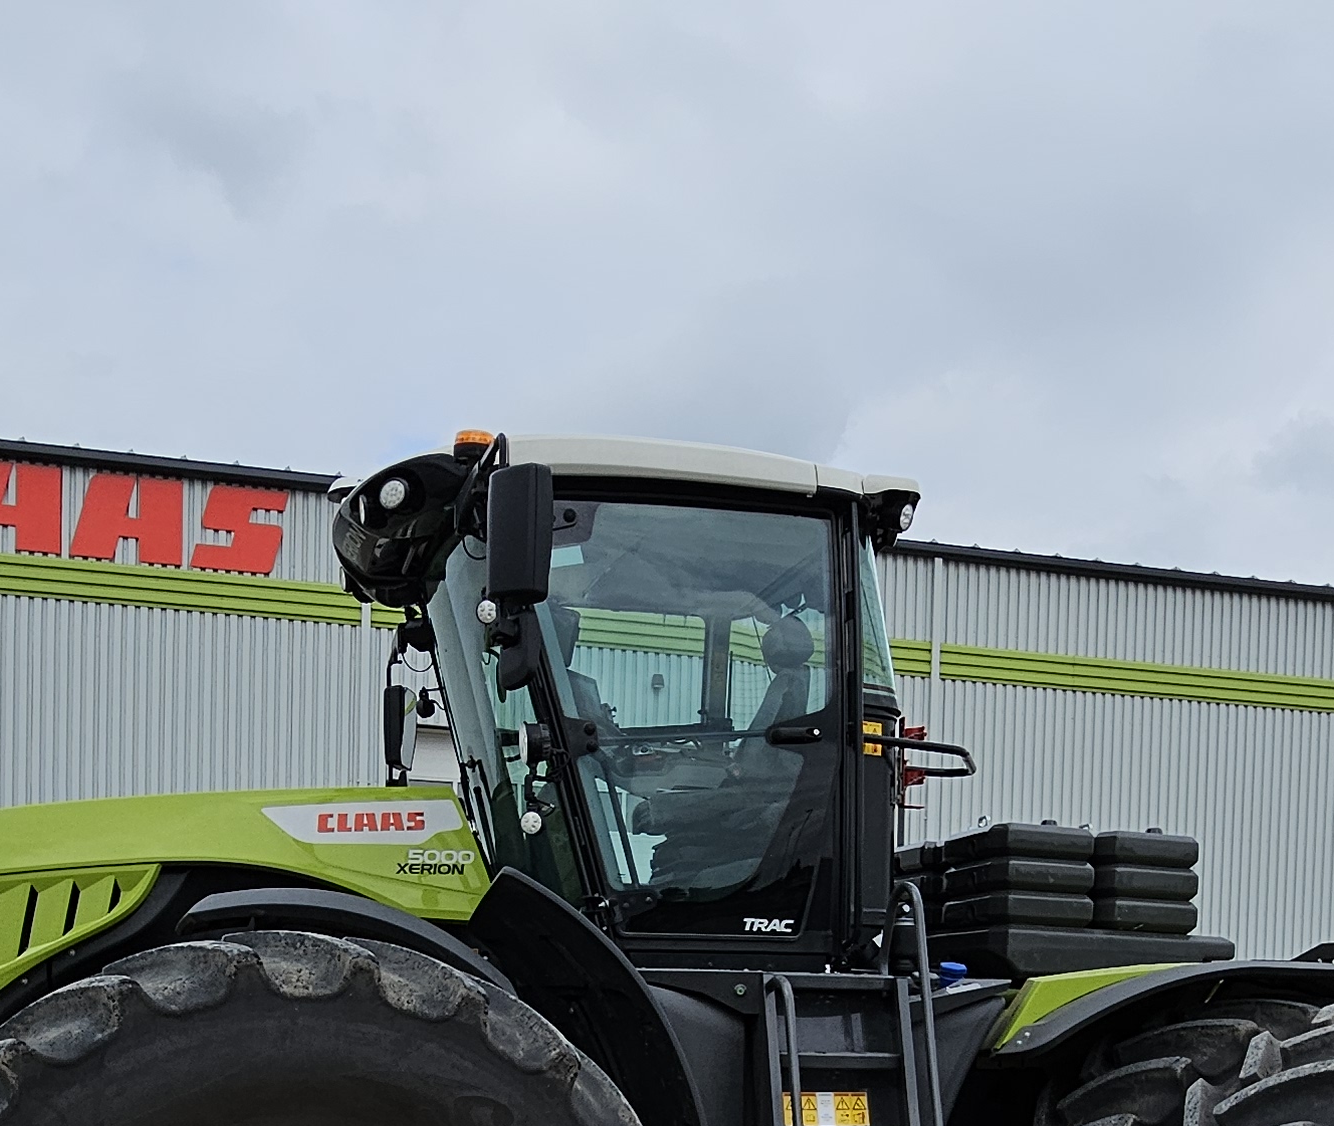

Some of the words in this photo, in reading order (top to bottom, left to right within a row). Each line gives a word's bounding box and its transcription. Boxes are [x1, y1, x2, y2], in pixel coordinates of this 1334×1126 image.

[317, 812, 425, 832] CLAAS
[407, 849, 475, 864] 5000
[395, 862, 465, 875] XERION
[743, 917, 795, 933] TRAC
